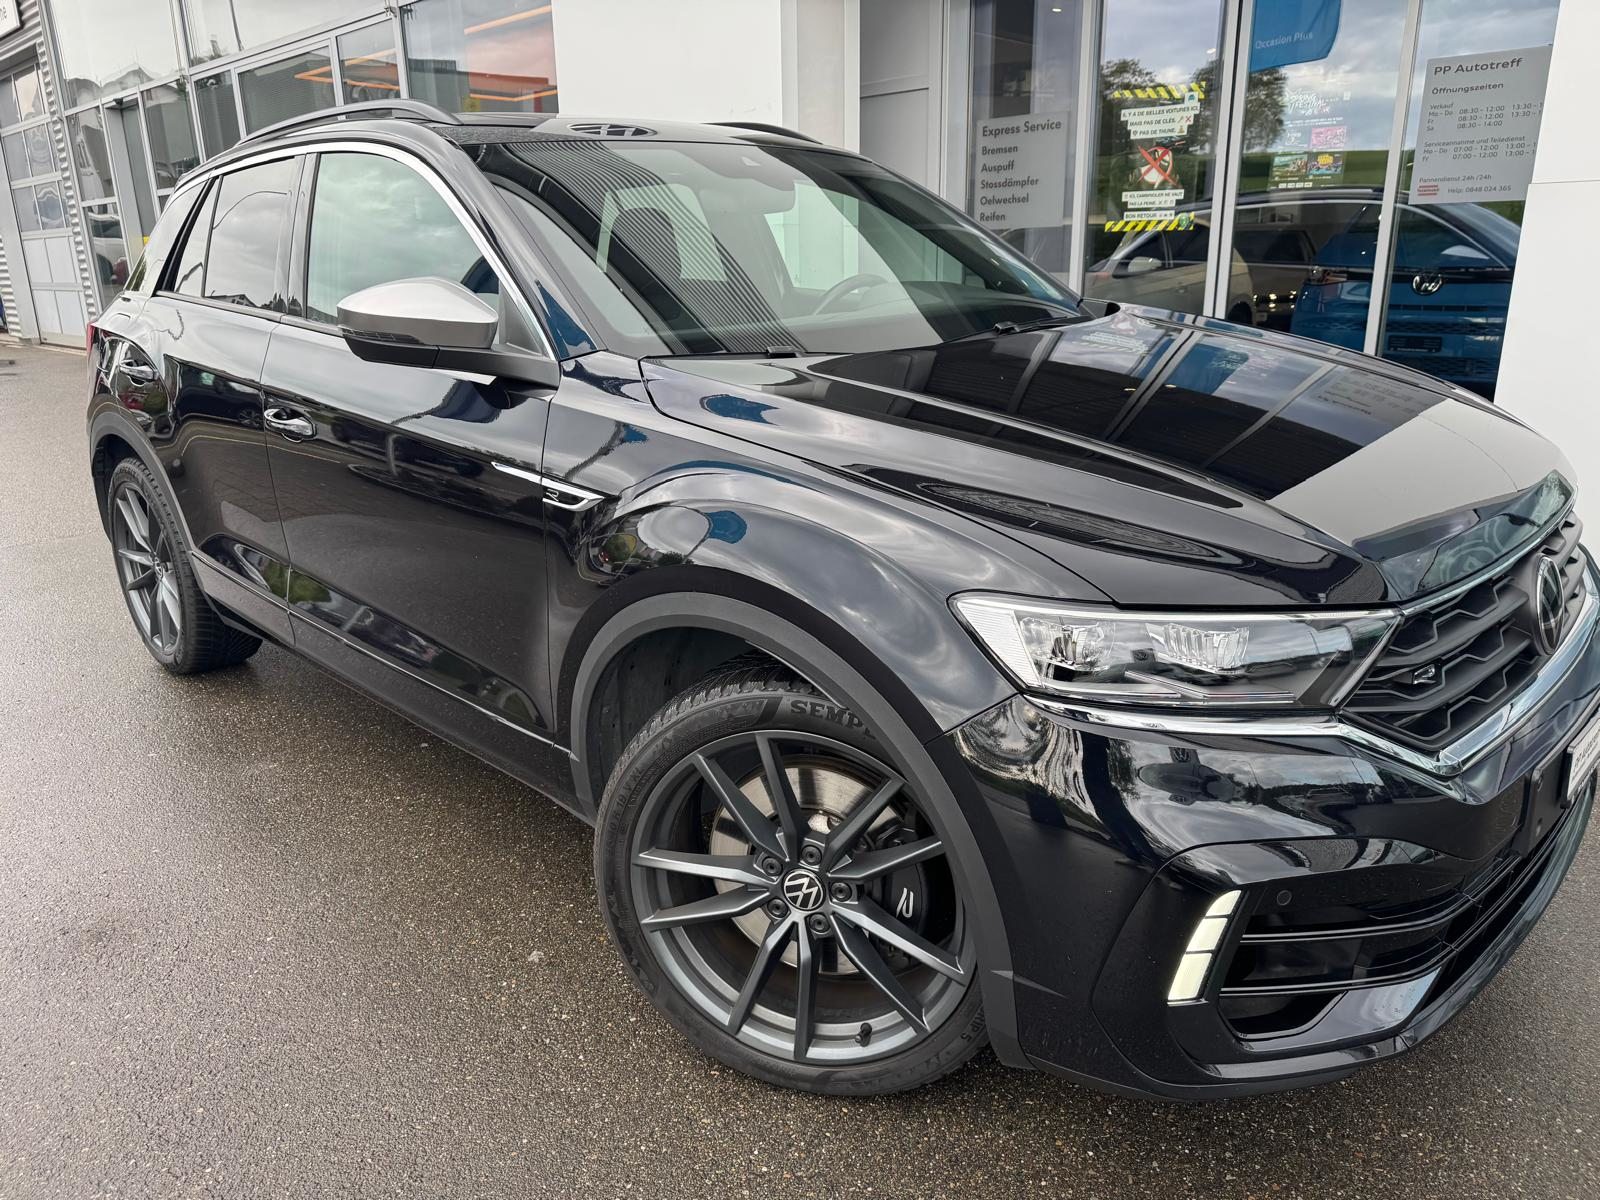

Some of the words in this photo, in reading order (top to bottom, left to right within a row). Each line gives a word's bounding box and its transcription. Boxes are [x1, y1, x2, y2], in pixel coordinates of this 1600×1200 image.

[1256, 34, 1292, 49] Occasion
[1293, 30, 1313, 42] Plus
[1434, 66, 1451, 75] PP
[1454, 58, 1523, 74] Autotreff
[1432, 83, 1504, 95] Öffnungszeiten
[982, 125, 1020, 138] Express
[1023, 119, 1061, 132] Service
[981, 145, 1018, 156] Bremsen
[981, 160, 1015, 173] Auspuff
[980, 176, 1039, 189] Stossdämpfer
[980, 193, 1029, 205] Oelwechsel
[980, 212, 1005, 222] Reifen
[790, 700, 876, 740] SEMP
